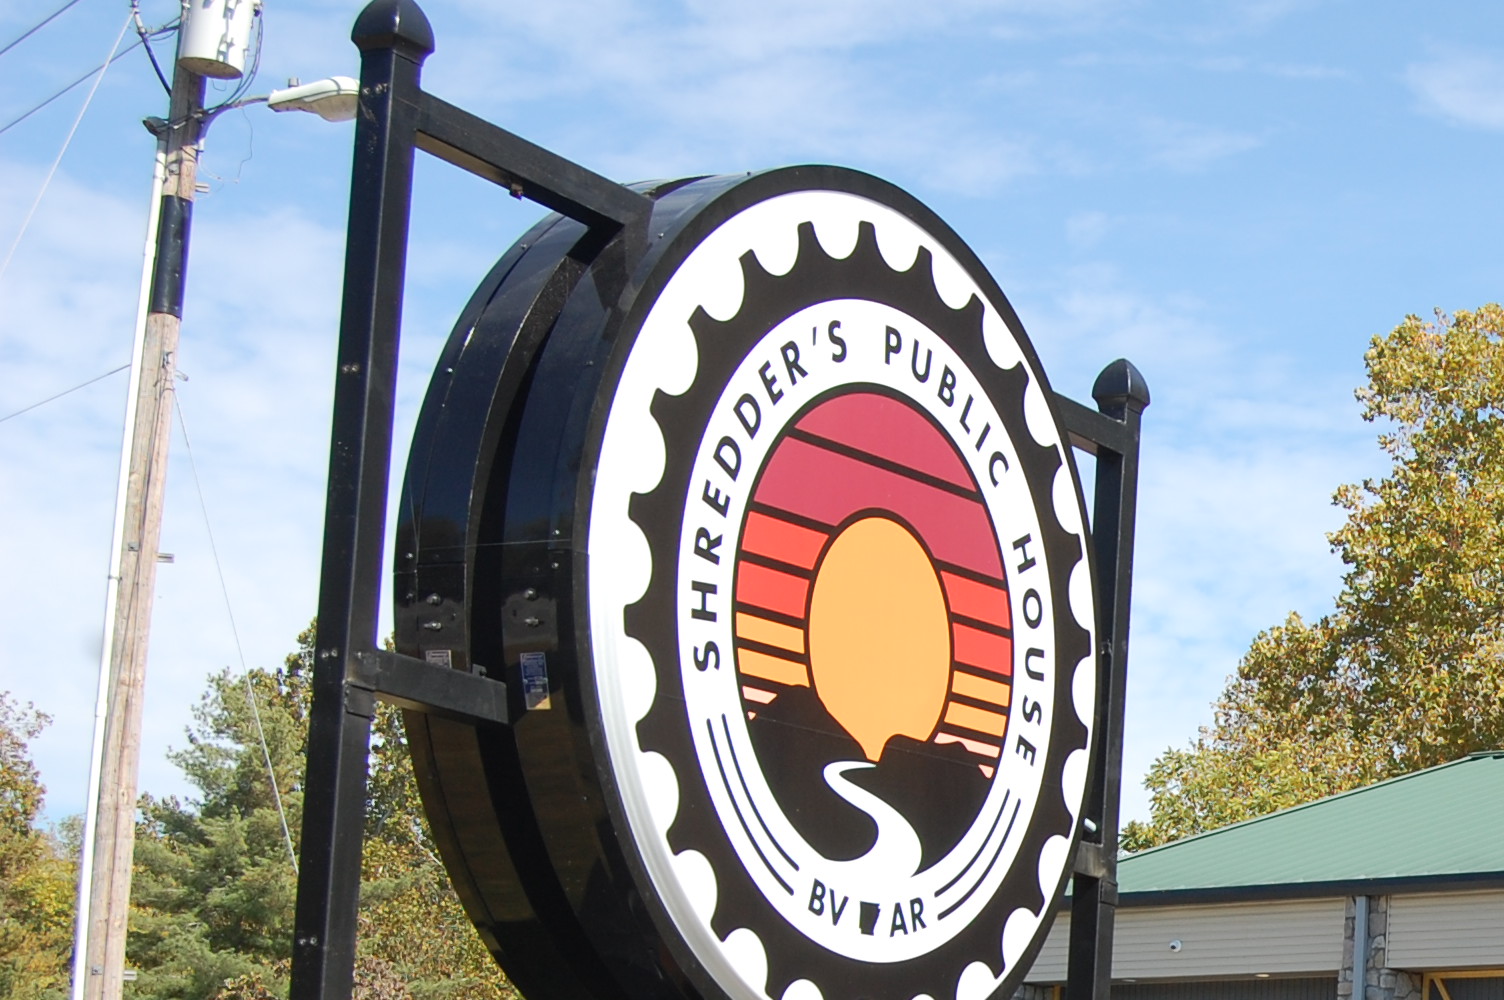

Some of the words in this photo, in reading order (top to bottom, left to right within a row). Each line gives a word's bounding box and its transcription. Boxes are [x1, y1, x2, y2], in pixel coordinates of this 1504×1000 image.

[691, 320, 848, 672] SHREDDER'S
[885, 325, 1010, 489] PUBLIC
[1012, 533, 1045, 767] HOUSE
[808, 878, 849, 927] BV
[889, 896, 928, 937] AR
